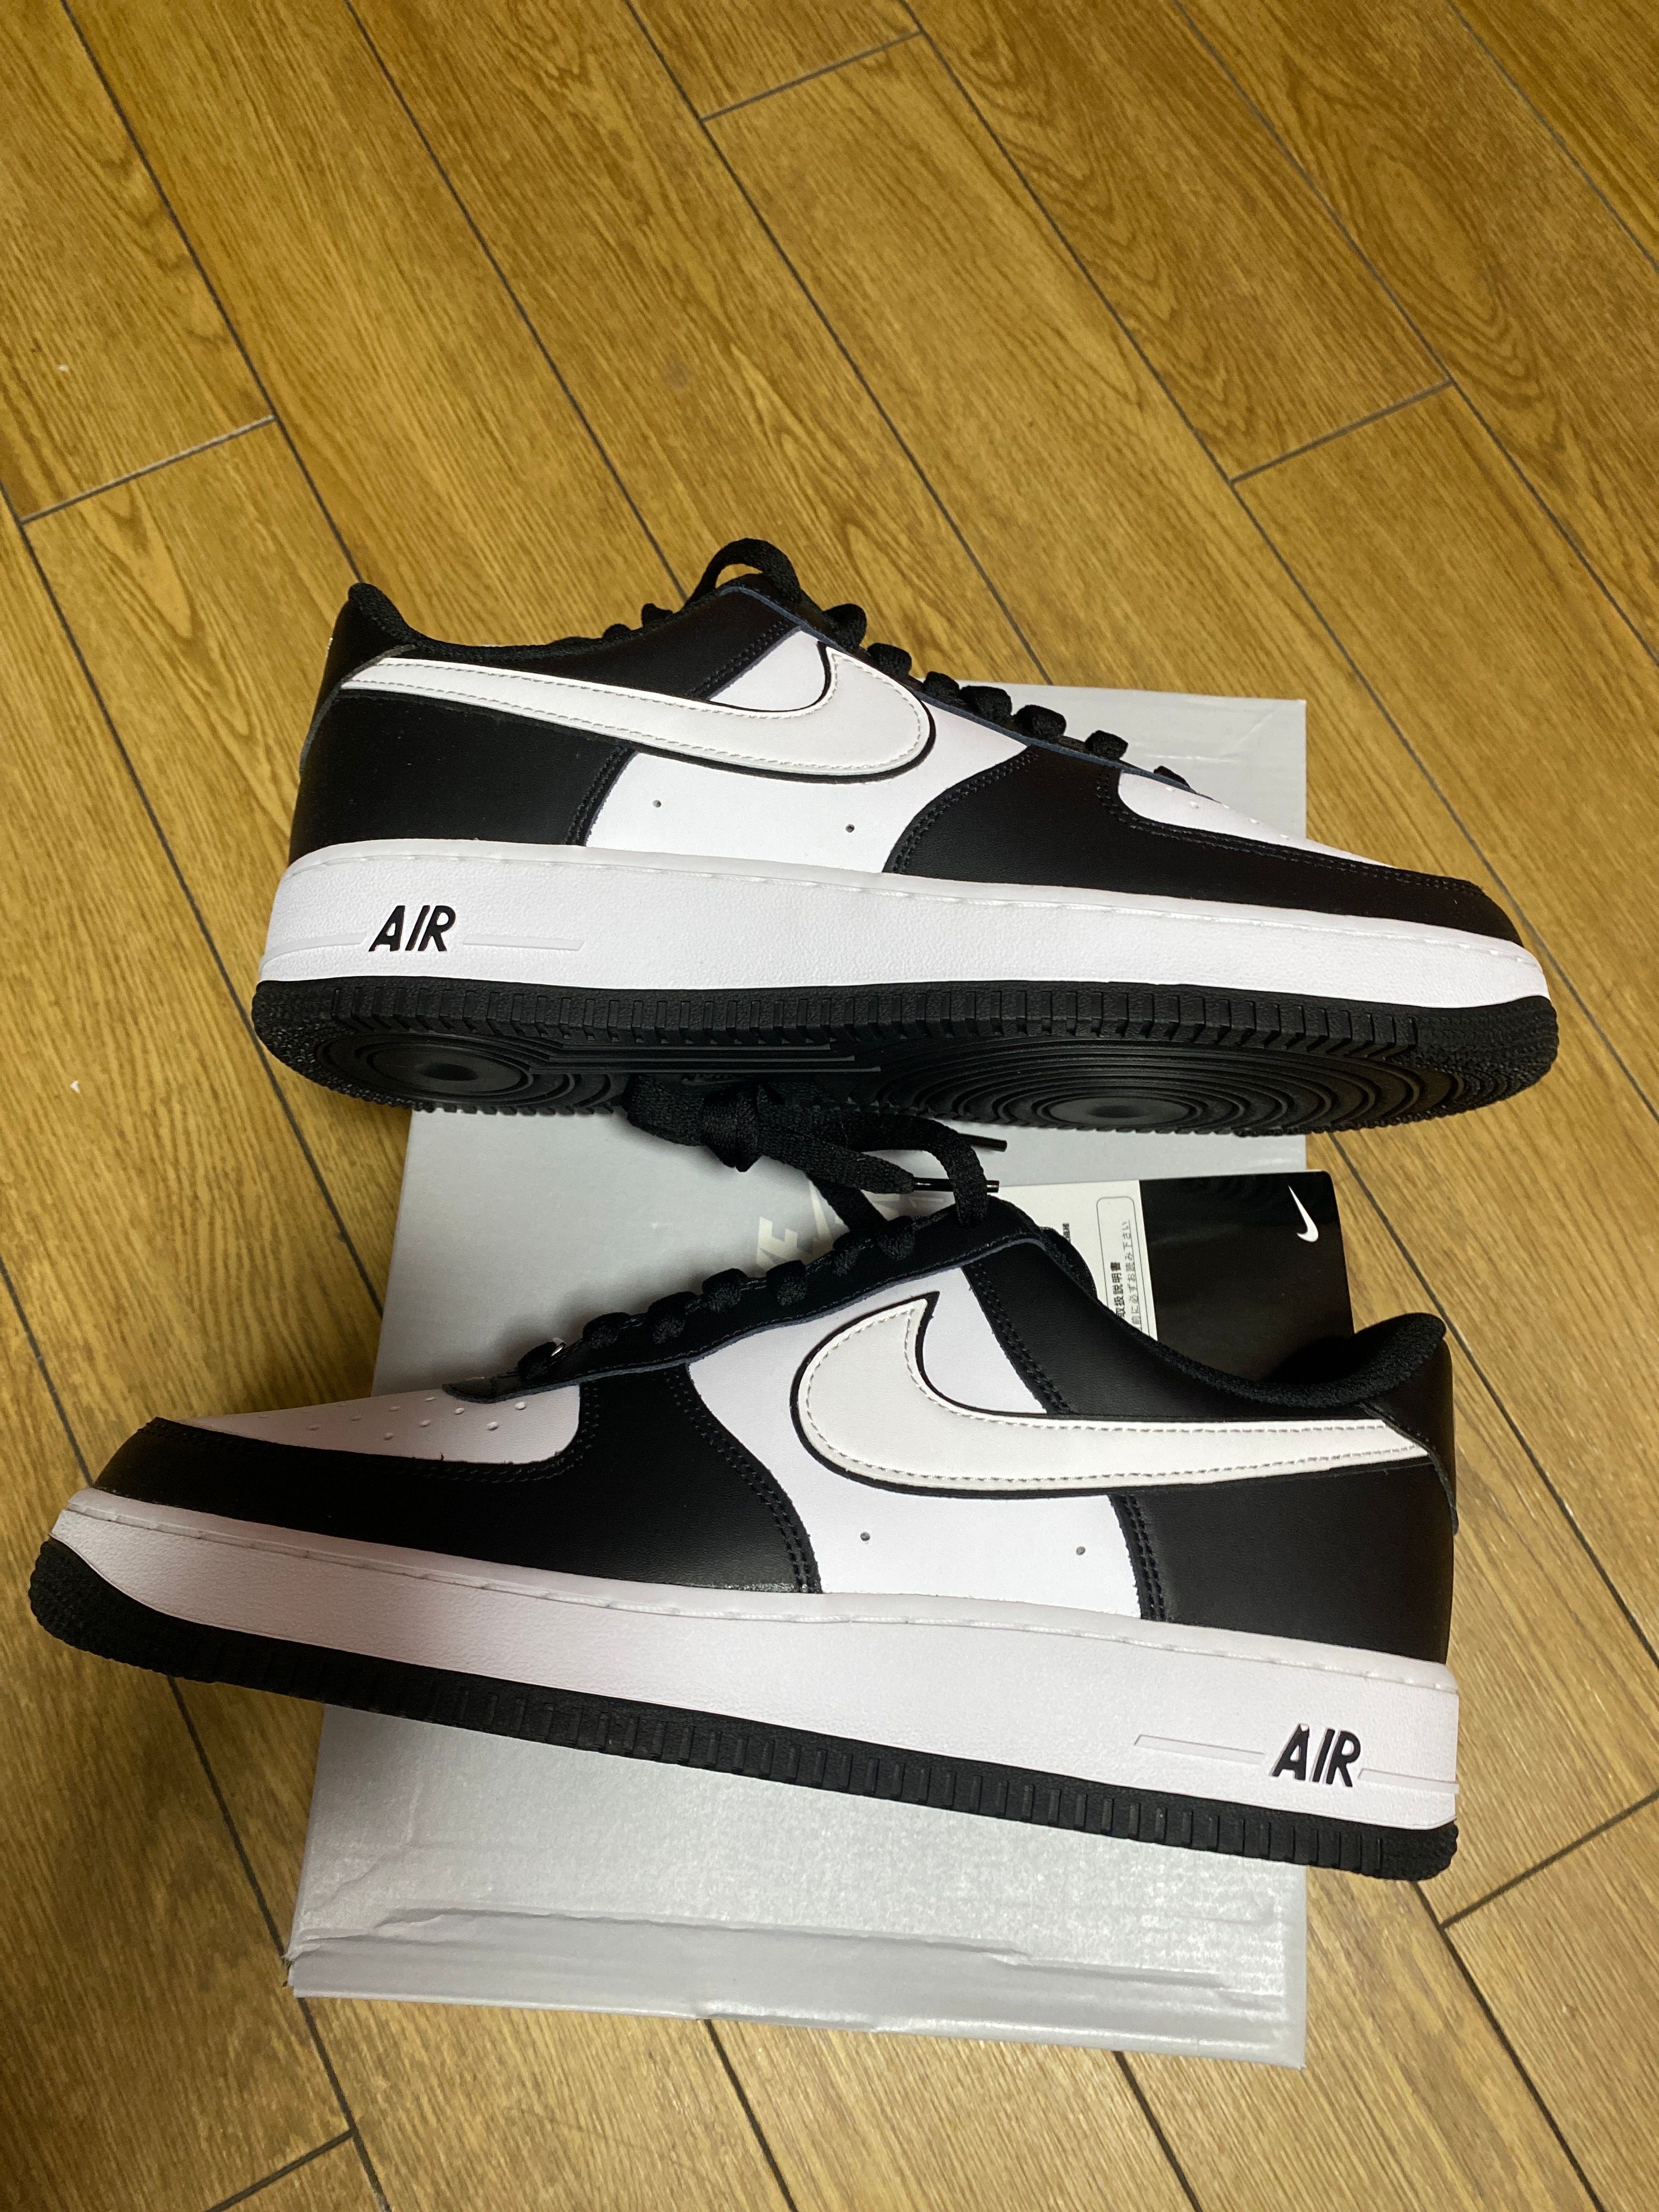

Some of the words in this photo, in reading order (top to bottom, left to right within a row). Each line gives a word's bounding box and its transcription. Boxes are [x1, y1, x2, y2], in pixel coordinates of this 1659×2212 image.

[368, 905, 456, 952] AIR
[1122, 1221, 1142, 1329] 前に必ずお読み下さい
[1269, 1723, 1361, 1787] AIR
